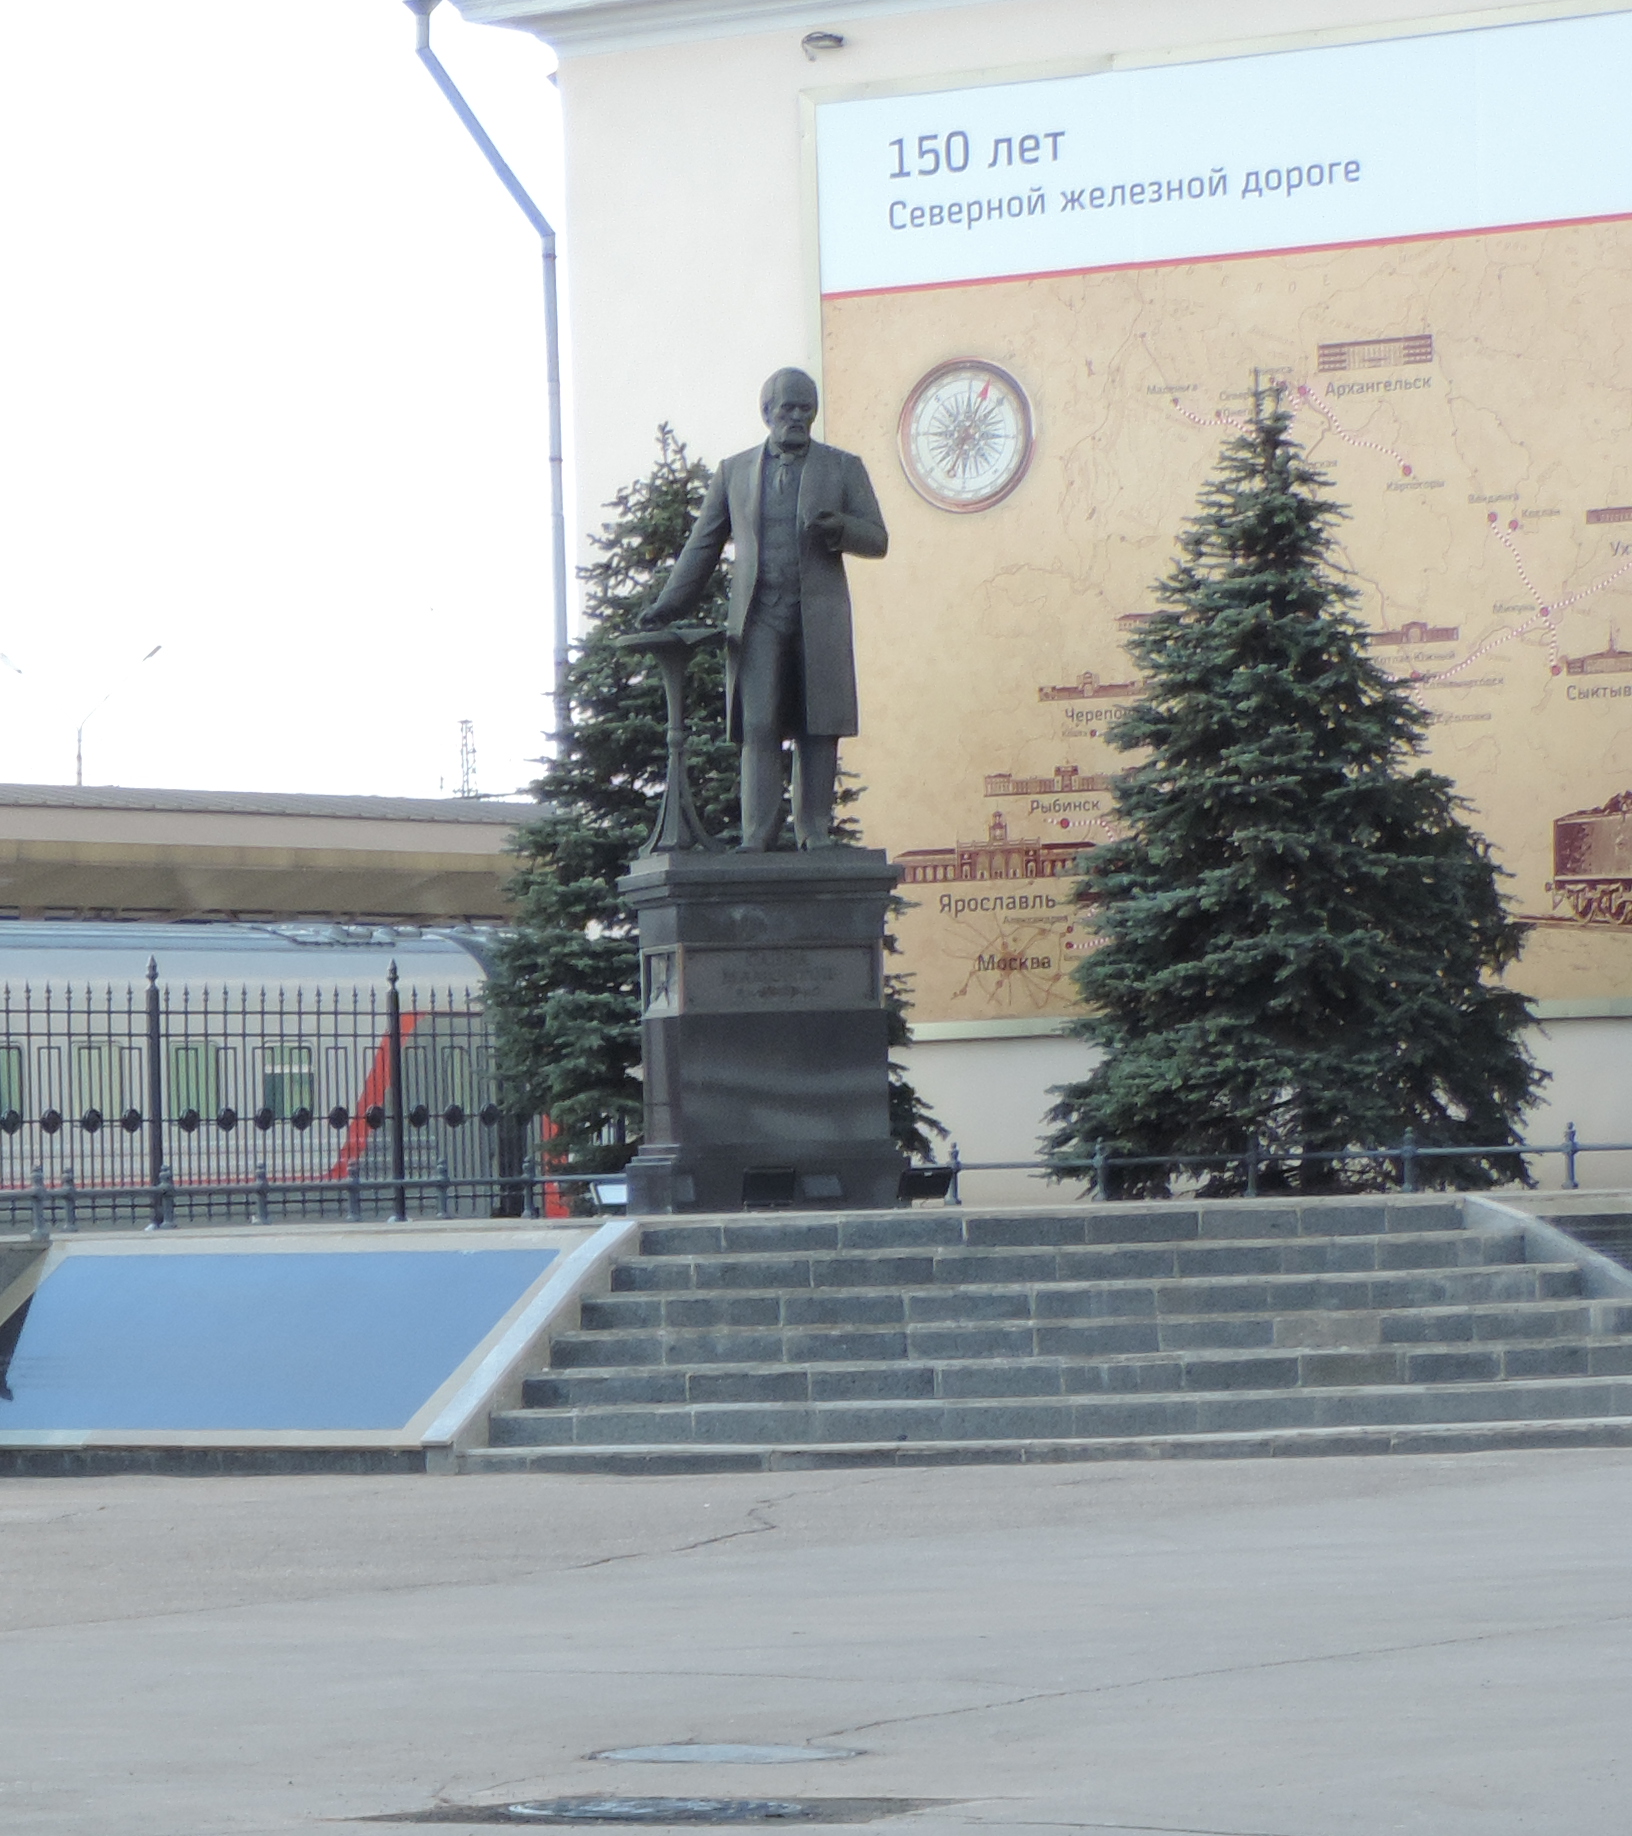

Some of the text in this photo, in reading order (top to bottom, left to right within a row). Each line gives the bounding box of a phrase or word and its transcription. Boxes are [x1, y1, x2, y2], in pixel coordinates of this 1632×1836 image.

[889, 130, 1066, 179] 150 лет
[889, 159, 1361, 230] Северной железной дороге
[1325, 376, 1432, 399] Архангельск
[1566, 685, 1632, 701] Сыктыв
[1065, 706, 1124, 725] Черепо
[1030, 799, 1101, 814] Рыбинск
[939, 893, 1057, 918] Ярославль
[977, 953, 1052, 972] Москва
